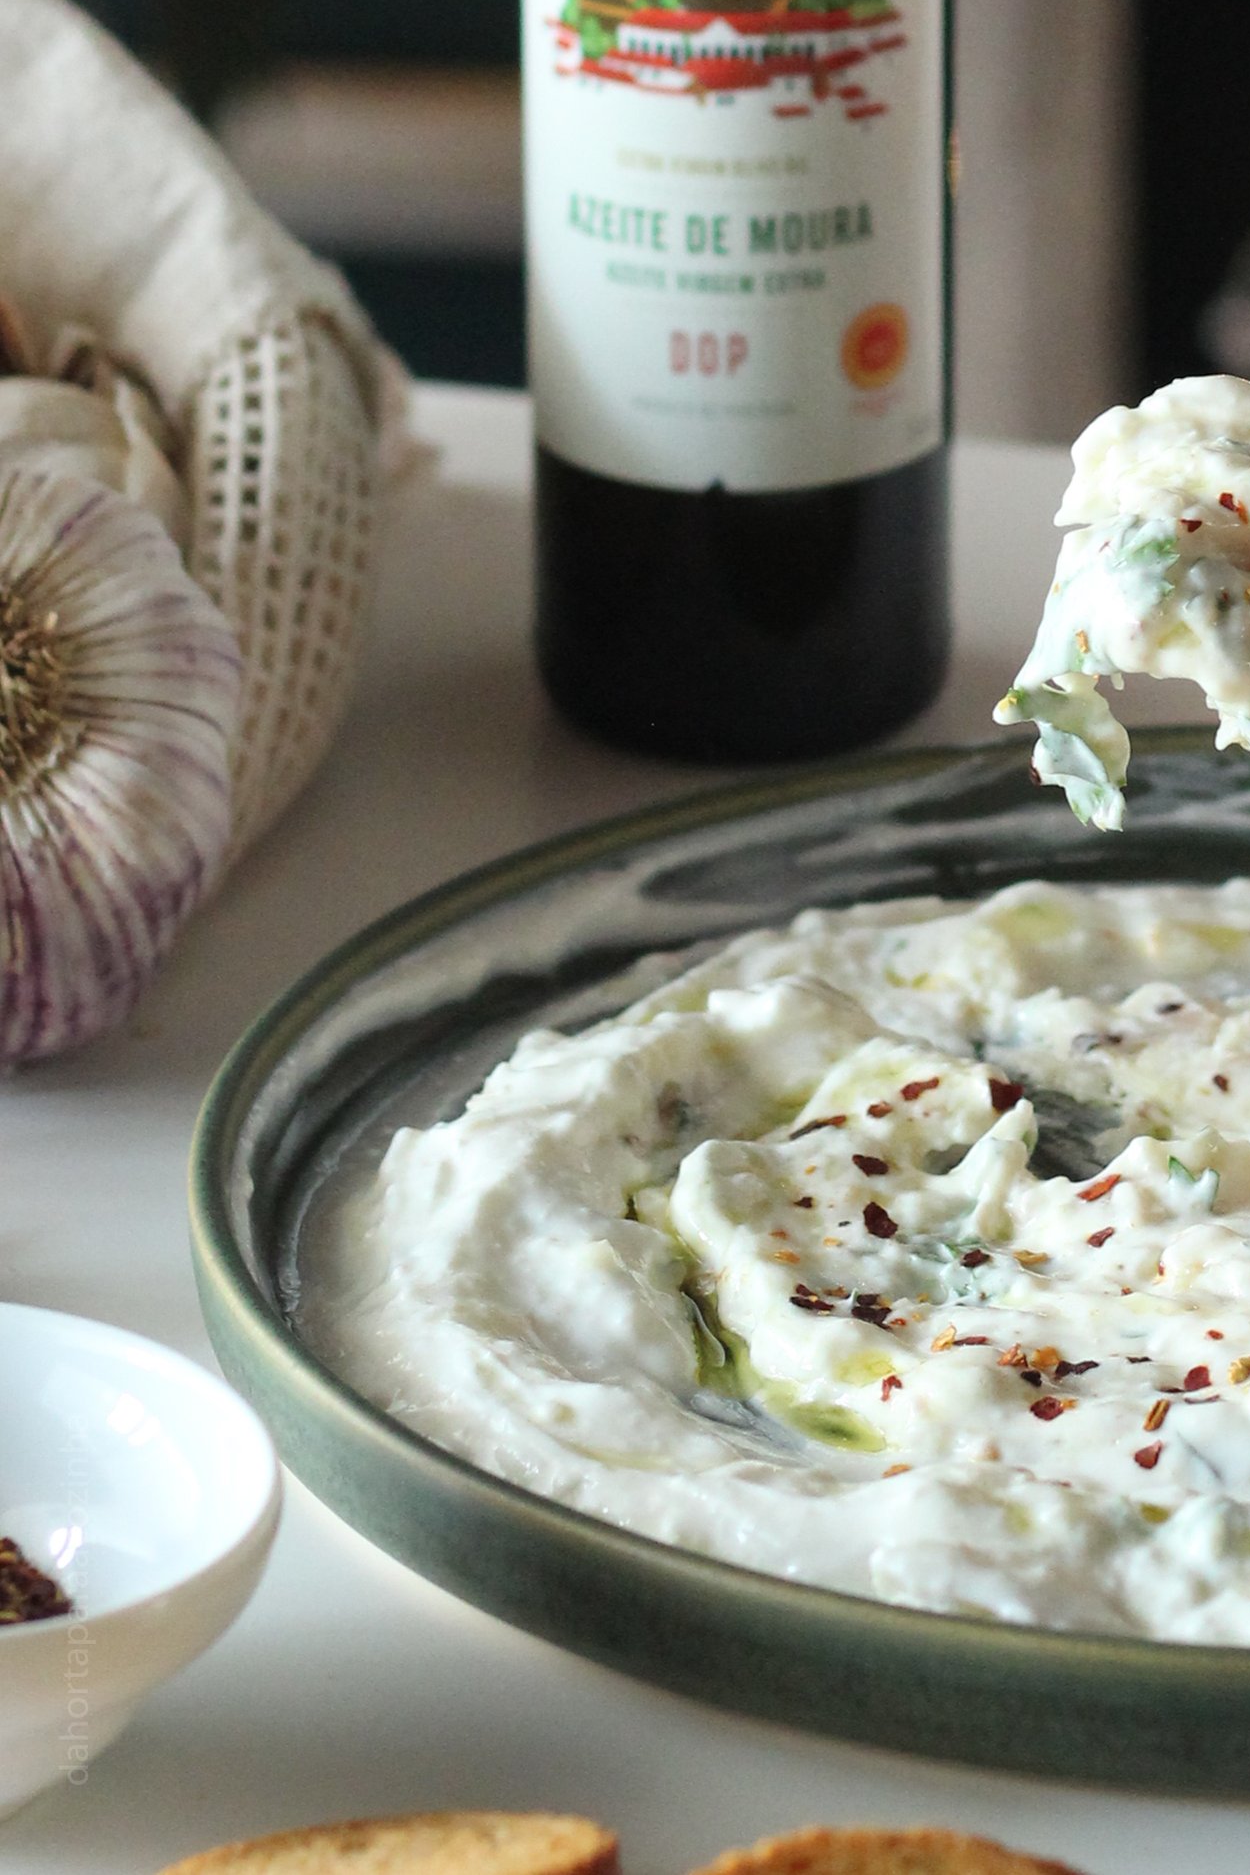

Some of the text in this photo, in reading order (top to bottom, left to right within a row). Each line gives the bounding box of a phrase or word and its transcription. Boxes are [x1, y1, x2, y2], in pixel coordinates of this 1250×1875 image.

[568, 190, 874, 257] AZEITE DE MOURA
[669, 328, 750, 378] DOP
